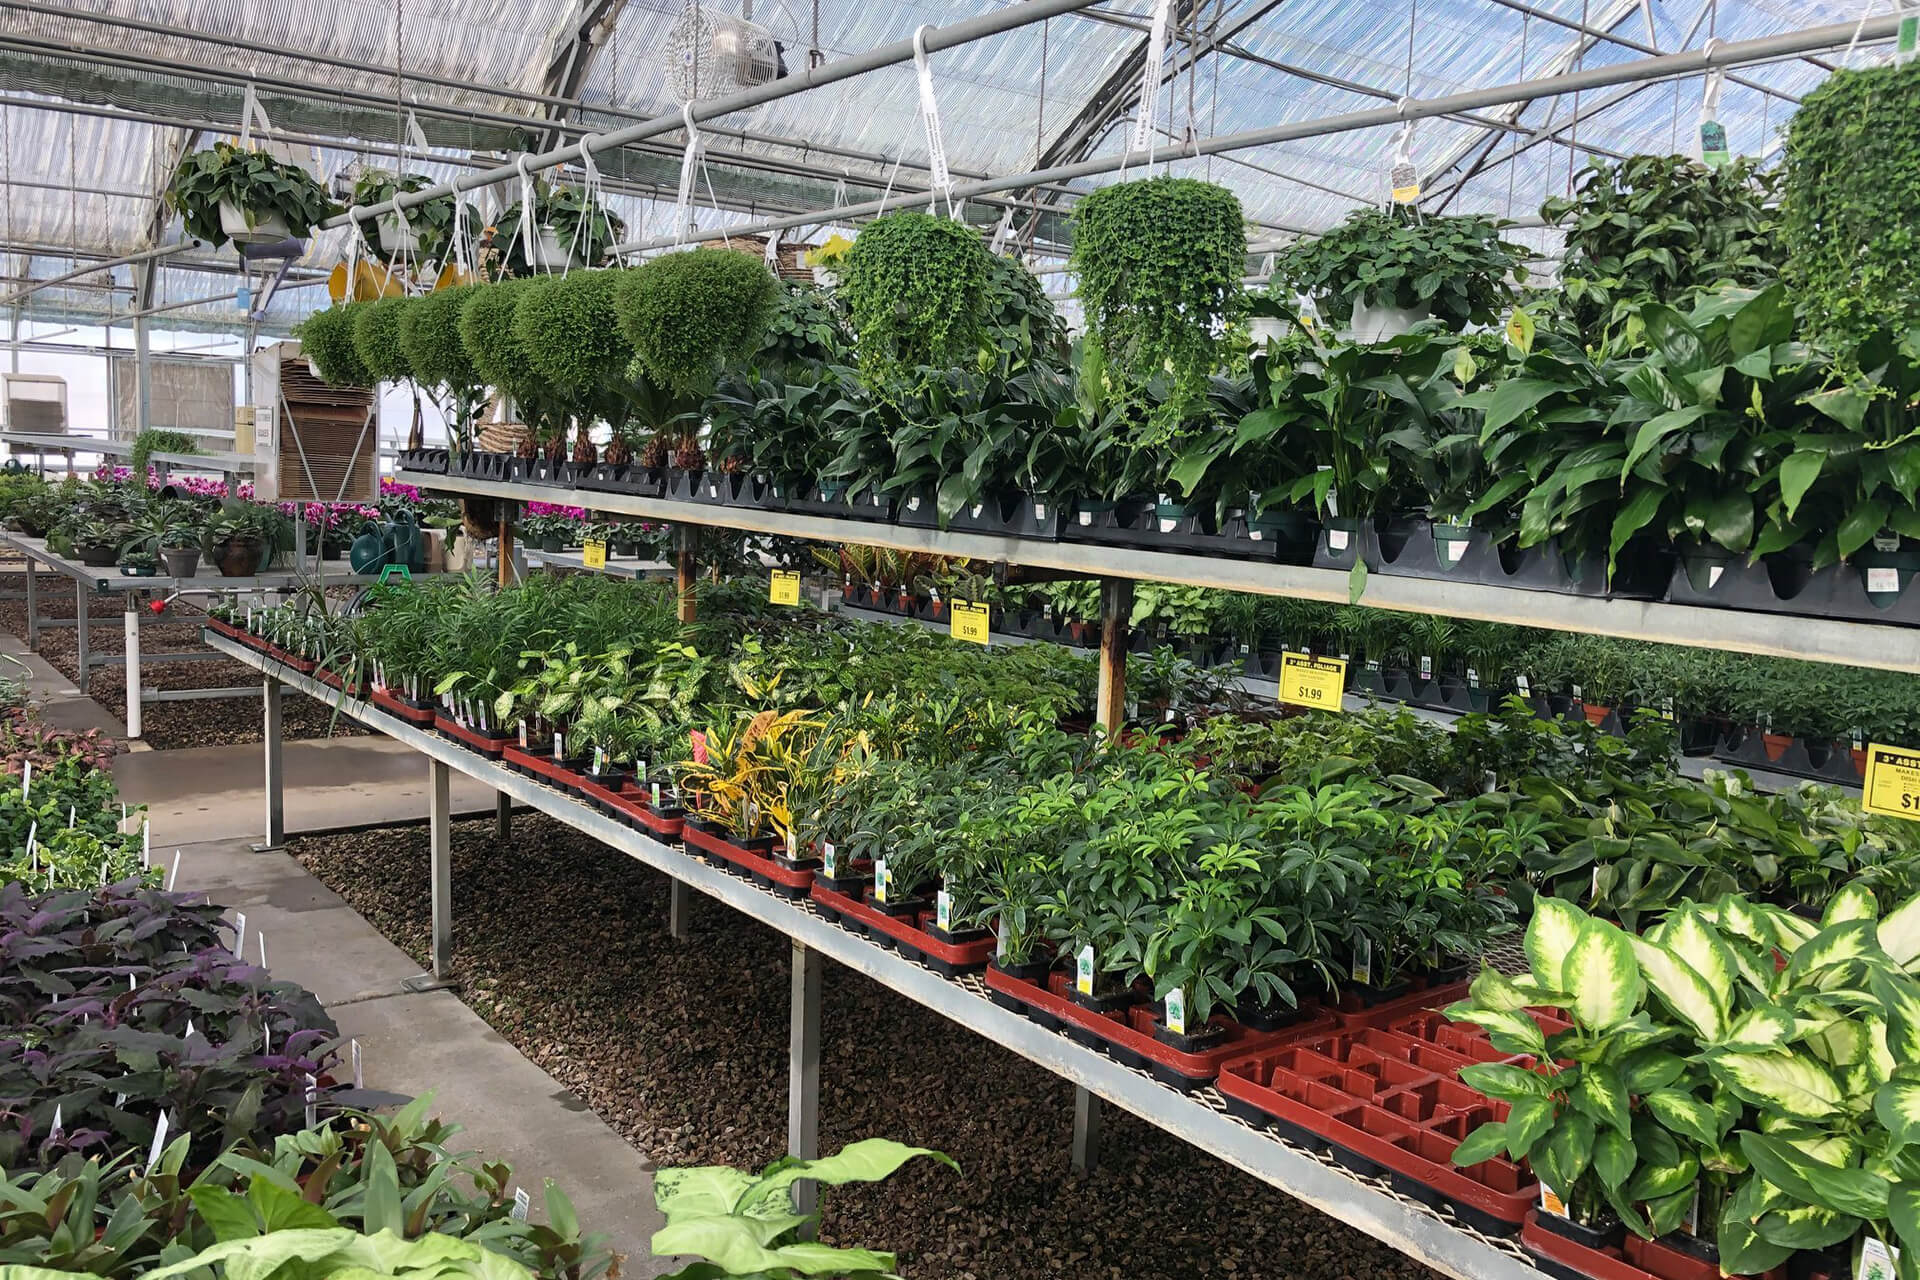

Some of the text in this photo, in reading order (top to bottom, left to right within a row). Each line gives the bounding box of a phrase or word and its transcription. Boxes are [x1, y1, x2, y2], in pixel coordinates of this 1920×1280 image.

[963, 625, 977, 636] $1.99
[1313, 662, 1337, 672] FOLIAGE
[1298, 686, 1322, 700] $1.99
[1896, 767, 1920, 776] MAKES
